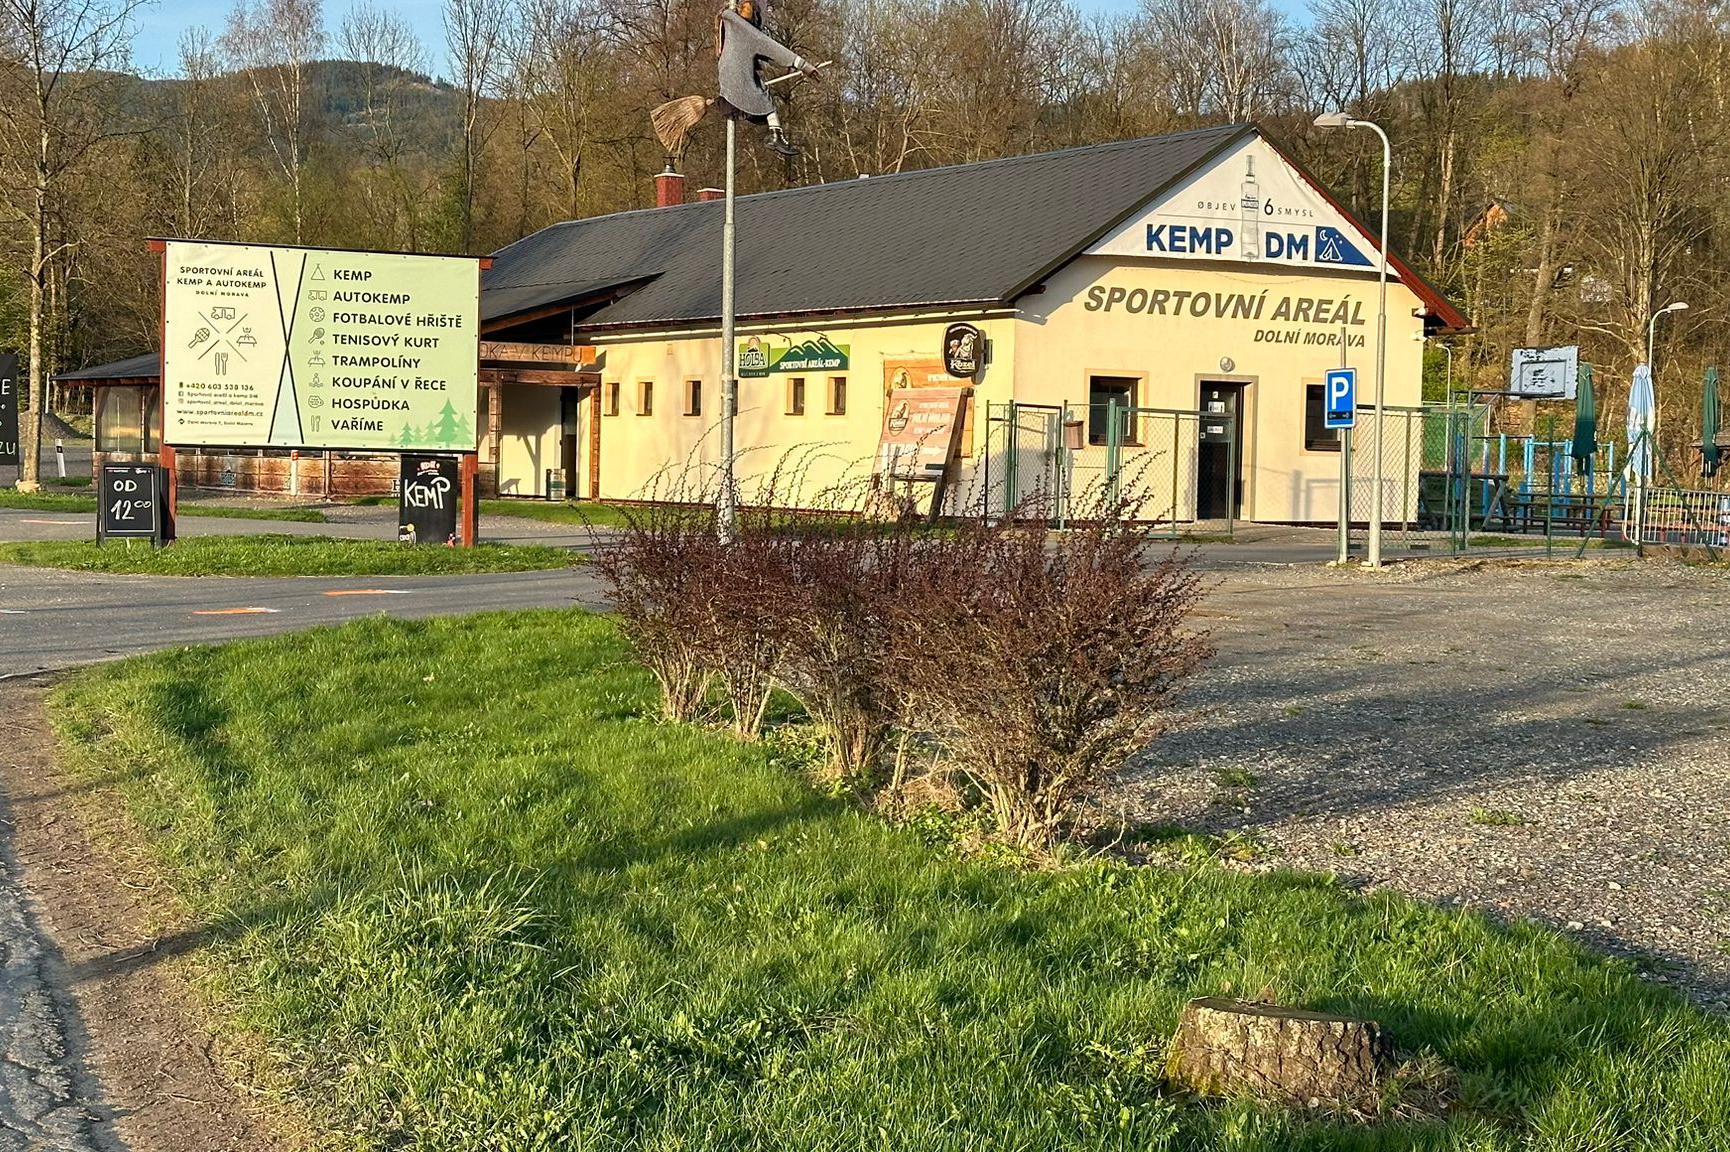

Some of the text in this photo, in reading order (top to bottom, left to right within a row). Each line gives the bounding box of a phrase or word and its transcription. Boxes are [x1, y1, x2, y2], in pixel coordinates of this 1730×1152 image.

[1264, 198, 1274, 215] 6
[1277, 207, 1314, 217] SMYSL
[1146, 224, 1309, 260] KEMP DM
[180, 266, 264, 278] SPORTOVNÍ AREÁL
[333, 269, 372, 281] KEMP
[216, 280, 267, 288] AUTOKEMP
[333, 290, 410, 304] AUTOKEMP
[1084, 285, 1366, 325] SPORTOVNÍ AREÁL
[332, 312, 462, 328] FOTBALOVÉ HŘIŠTĚ
[332, 334, 440, 348] TENISOVÝ KURT
[1254, 329, 1301, 344] DOLNÍ
[532, 346, 583, 362] KEMPU
[739, 353, 766, 367] HOLBA
[332, 355, 421, 368] TRAMPOLÍNY
[332, 376, 446, 390] KOUPÁNÍ V ŘECE
[1332, 377, 1349, 410] P
[332, 395, 410, 410] HOSPŮDKA
[332, 417, 384, 431] VAŘÍME
[114, 480, 137, 492] OD
[404, 476, 451, 509] KEMP
